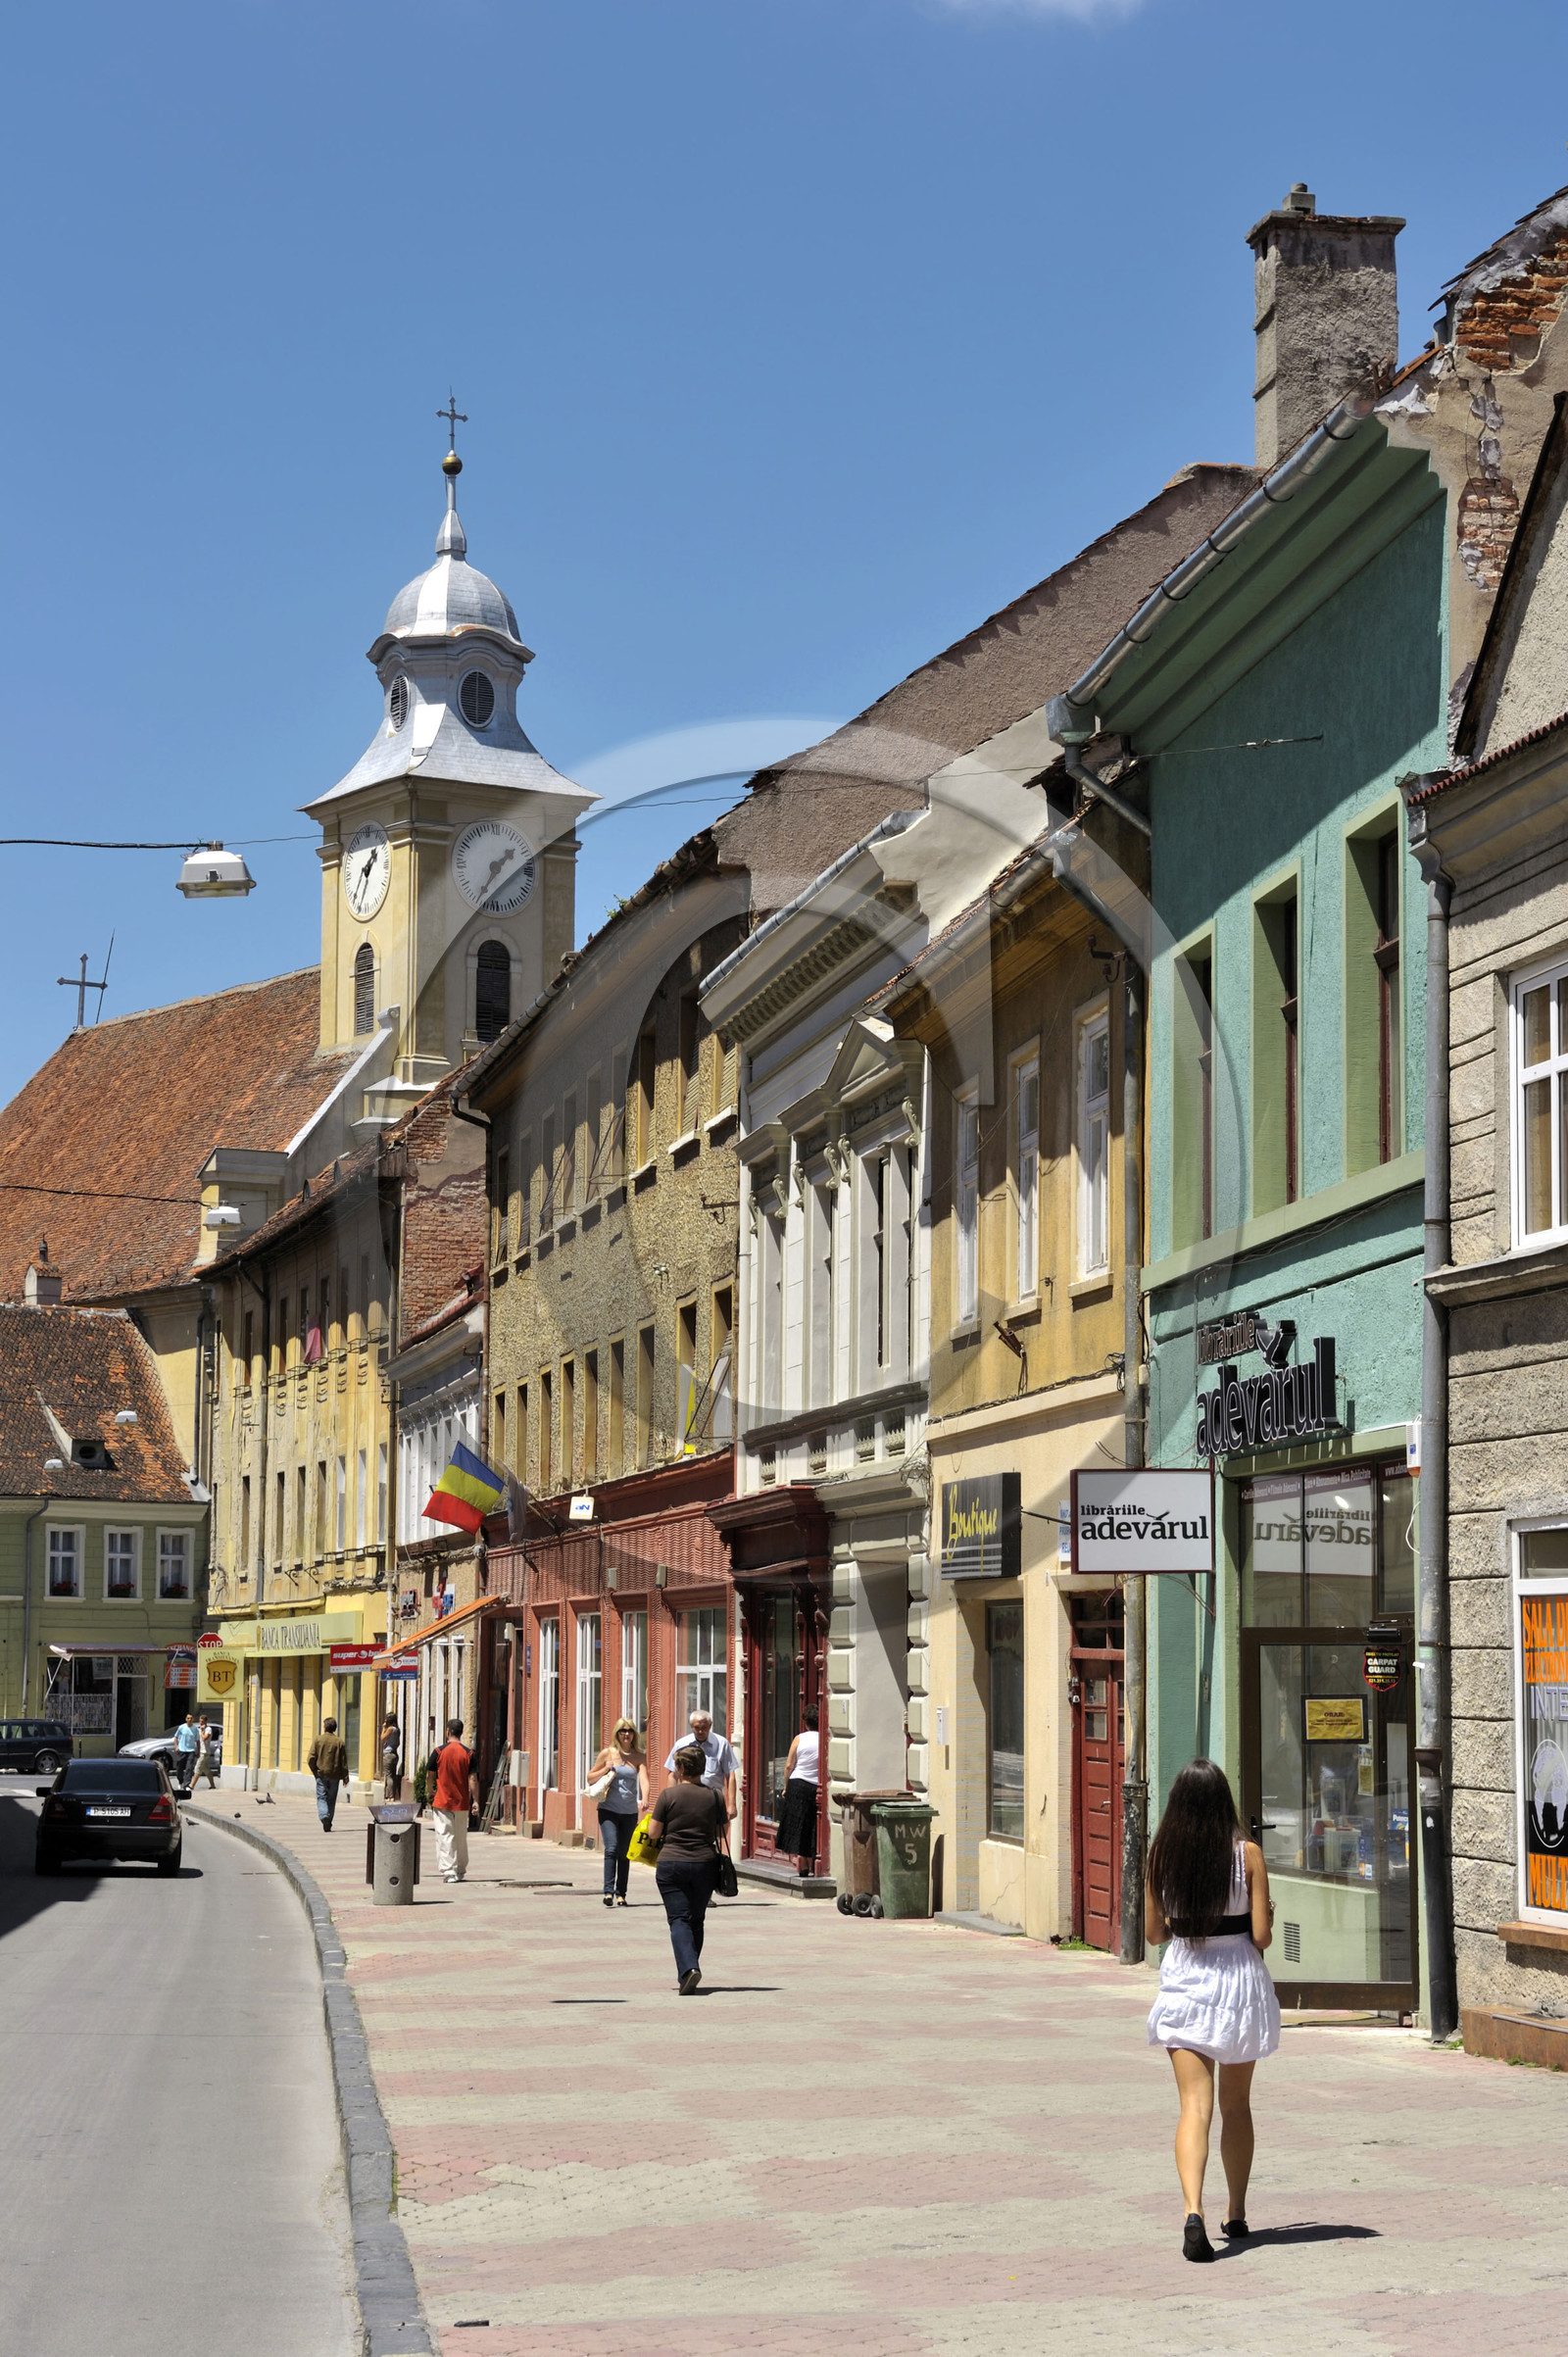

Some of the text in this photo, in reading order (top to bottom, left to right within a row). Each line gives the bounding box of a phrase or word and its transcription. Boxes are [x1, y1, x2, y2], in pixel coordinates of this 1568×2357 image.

[1080, 1504, 1146, 1516] librăriile
[947, 1484, 998, 1573] Boutique
[1081, 1514, 1209, 1541] adevărul
[1523, 1597, 1554, 1648] SALA
[213, 1671, 231, 1682] BT
[905, 1843, 917, 1865] 5
